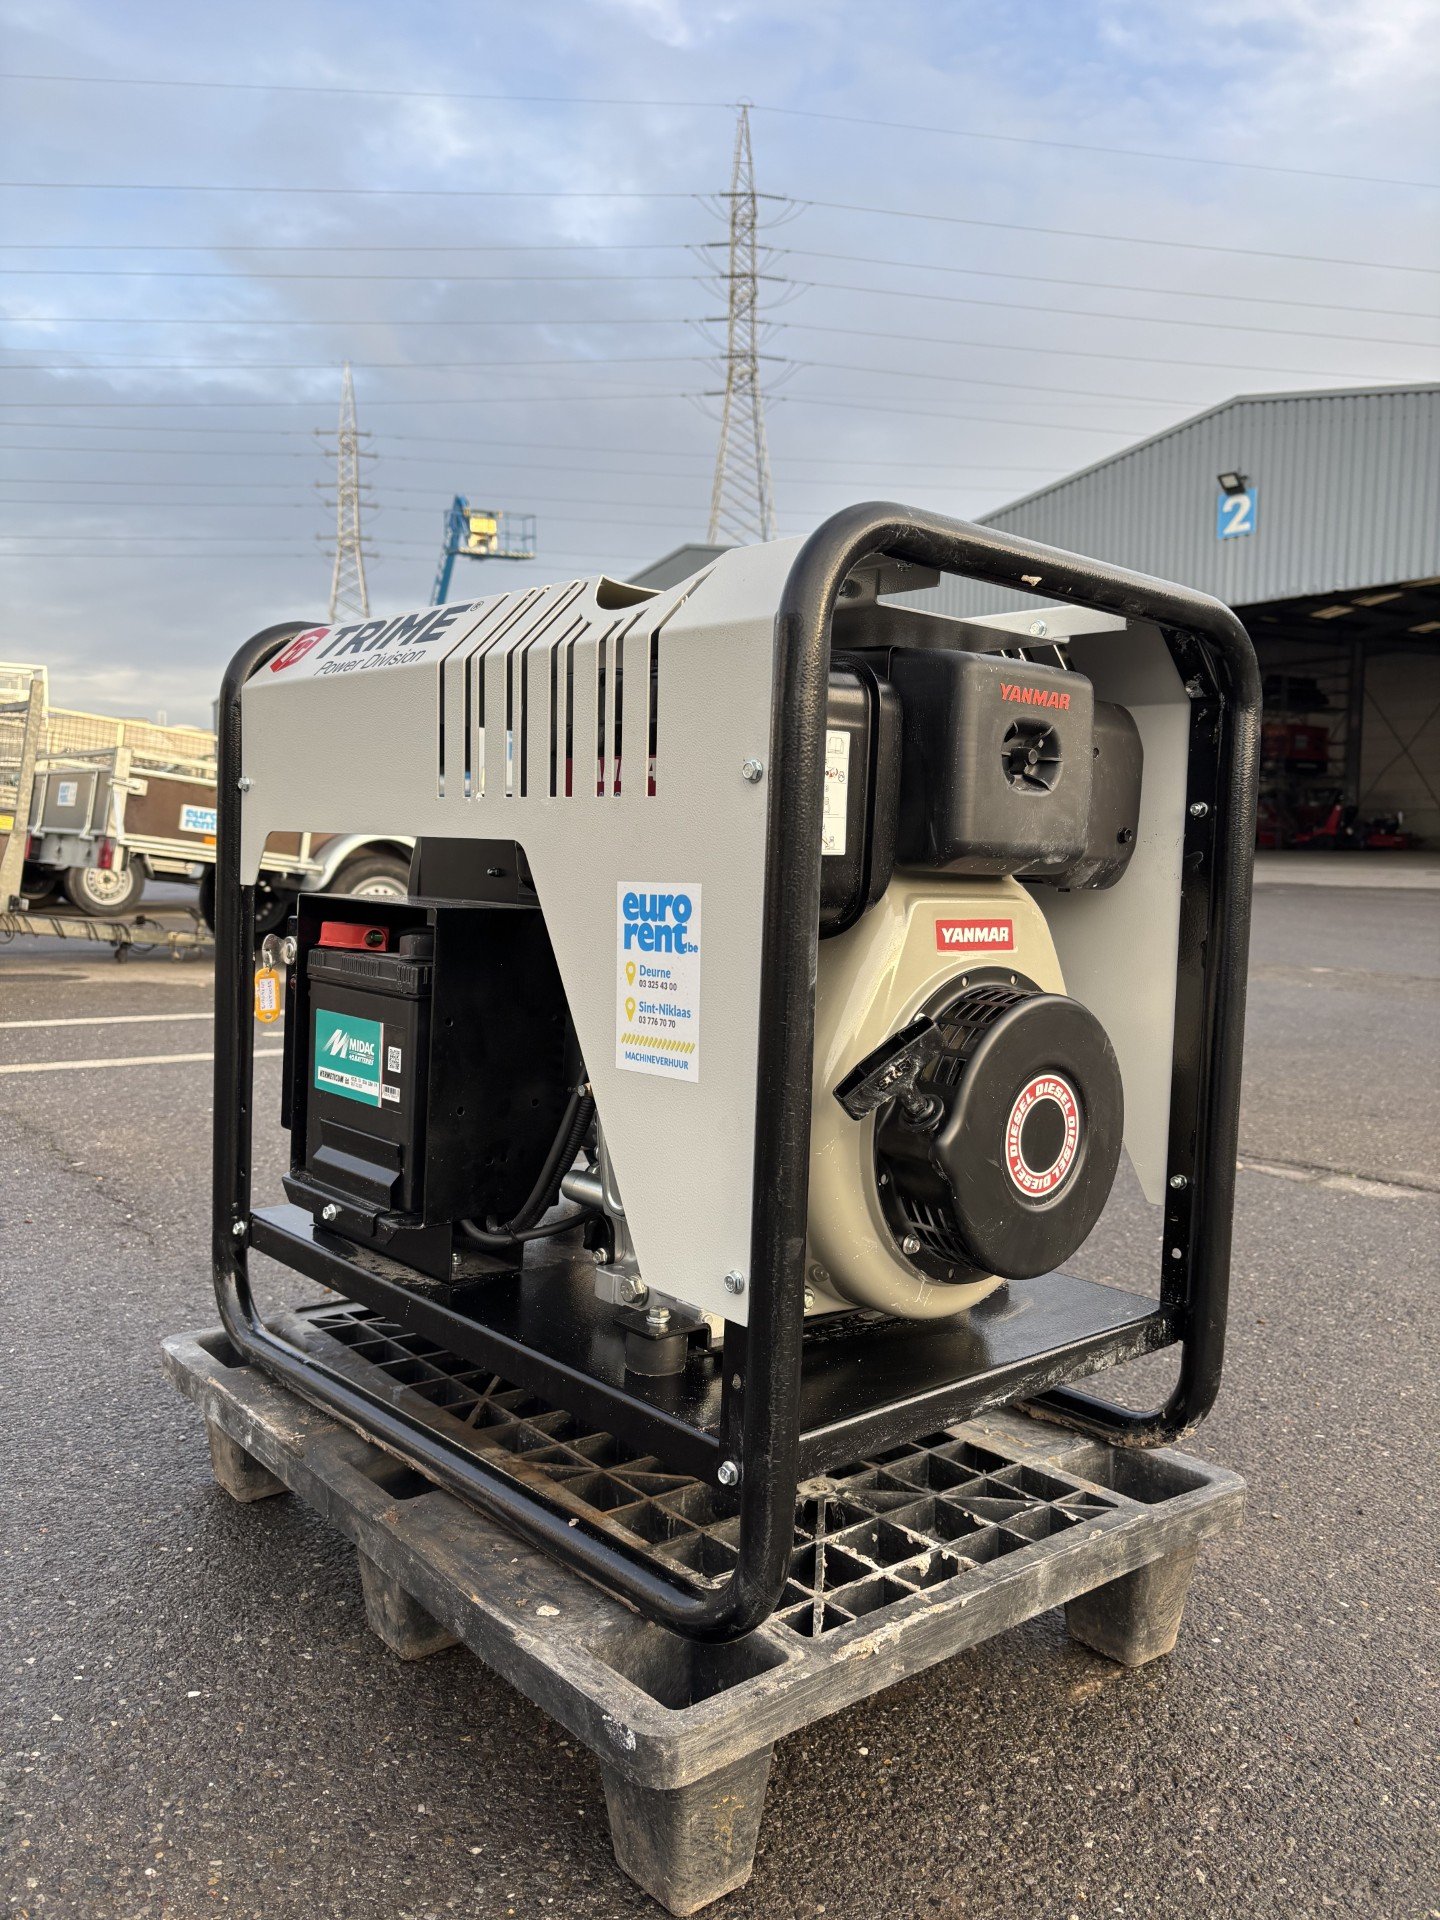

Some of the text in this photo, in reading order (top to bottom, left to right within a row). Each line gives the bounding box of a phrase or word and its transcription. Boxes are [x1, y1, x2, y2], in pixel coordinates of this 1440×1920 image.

[1222, 494, 1251, 534] 2
[314, 649, 426, 675] Power Division
[1000, 683, 1071, 710] YANMAR
[623, 892, 692, 923] euro
[941, 927, 1009, 943] YANMAR
[639, 965, 671, 978] Deurne
[639, 980, 677, 991] 03 325 43 00
[638, 1001, 691, 1018] Sint-Niklaas
[639, 1015, 676, 1028] 03 776 70 70
[349, 1038, 375, 1056] MIDAC
[625, 1051, 689, 1070] MACHINEVERHUUR
[1010, 1081, 1077, 1190] DIESEL DIESEL DIESEL DIESEL
